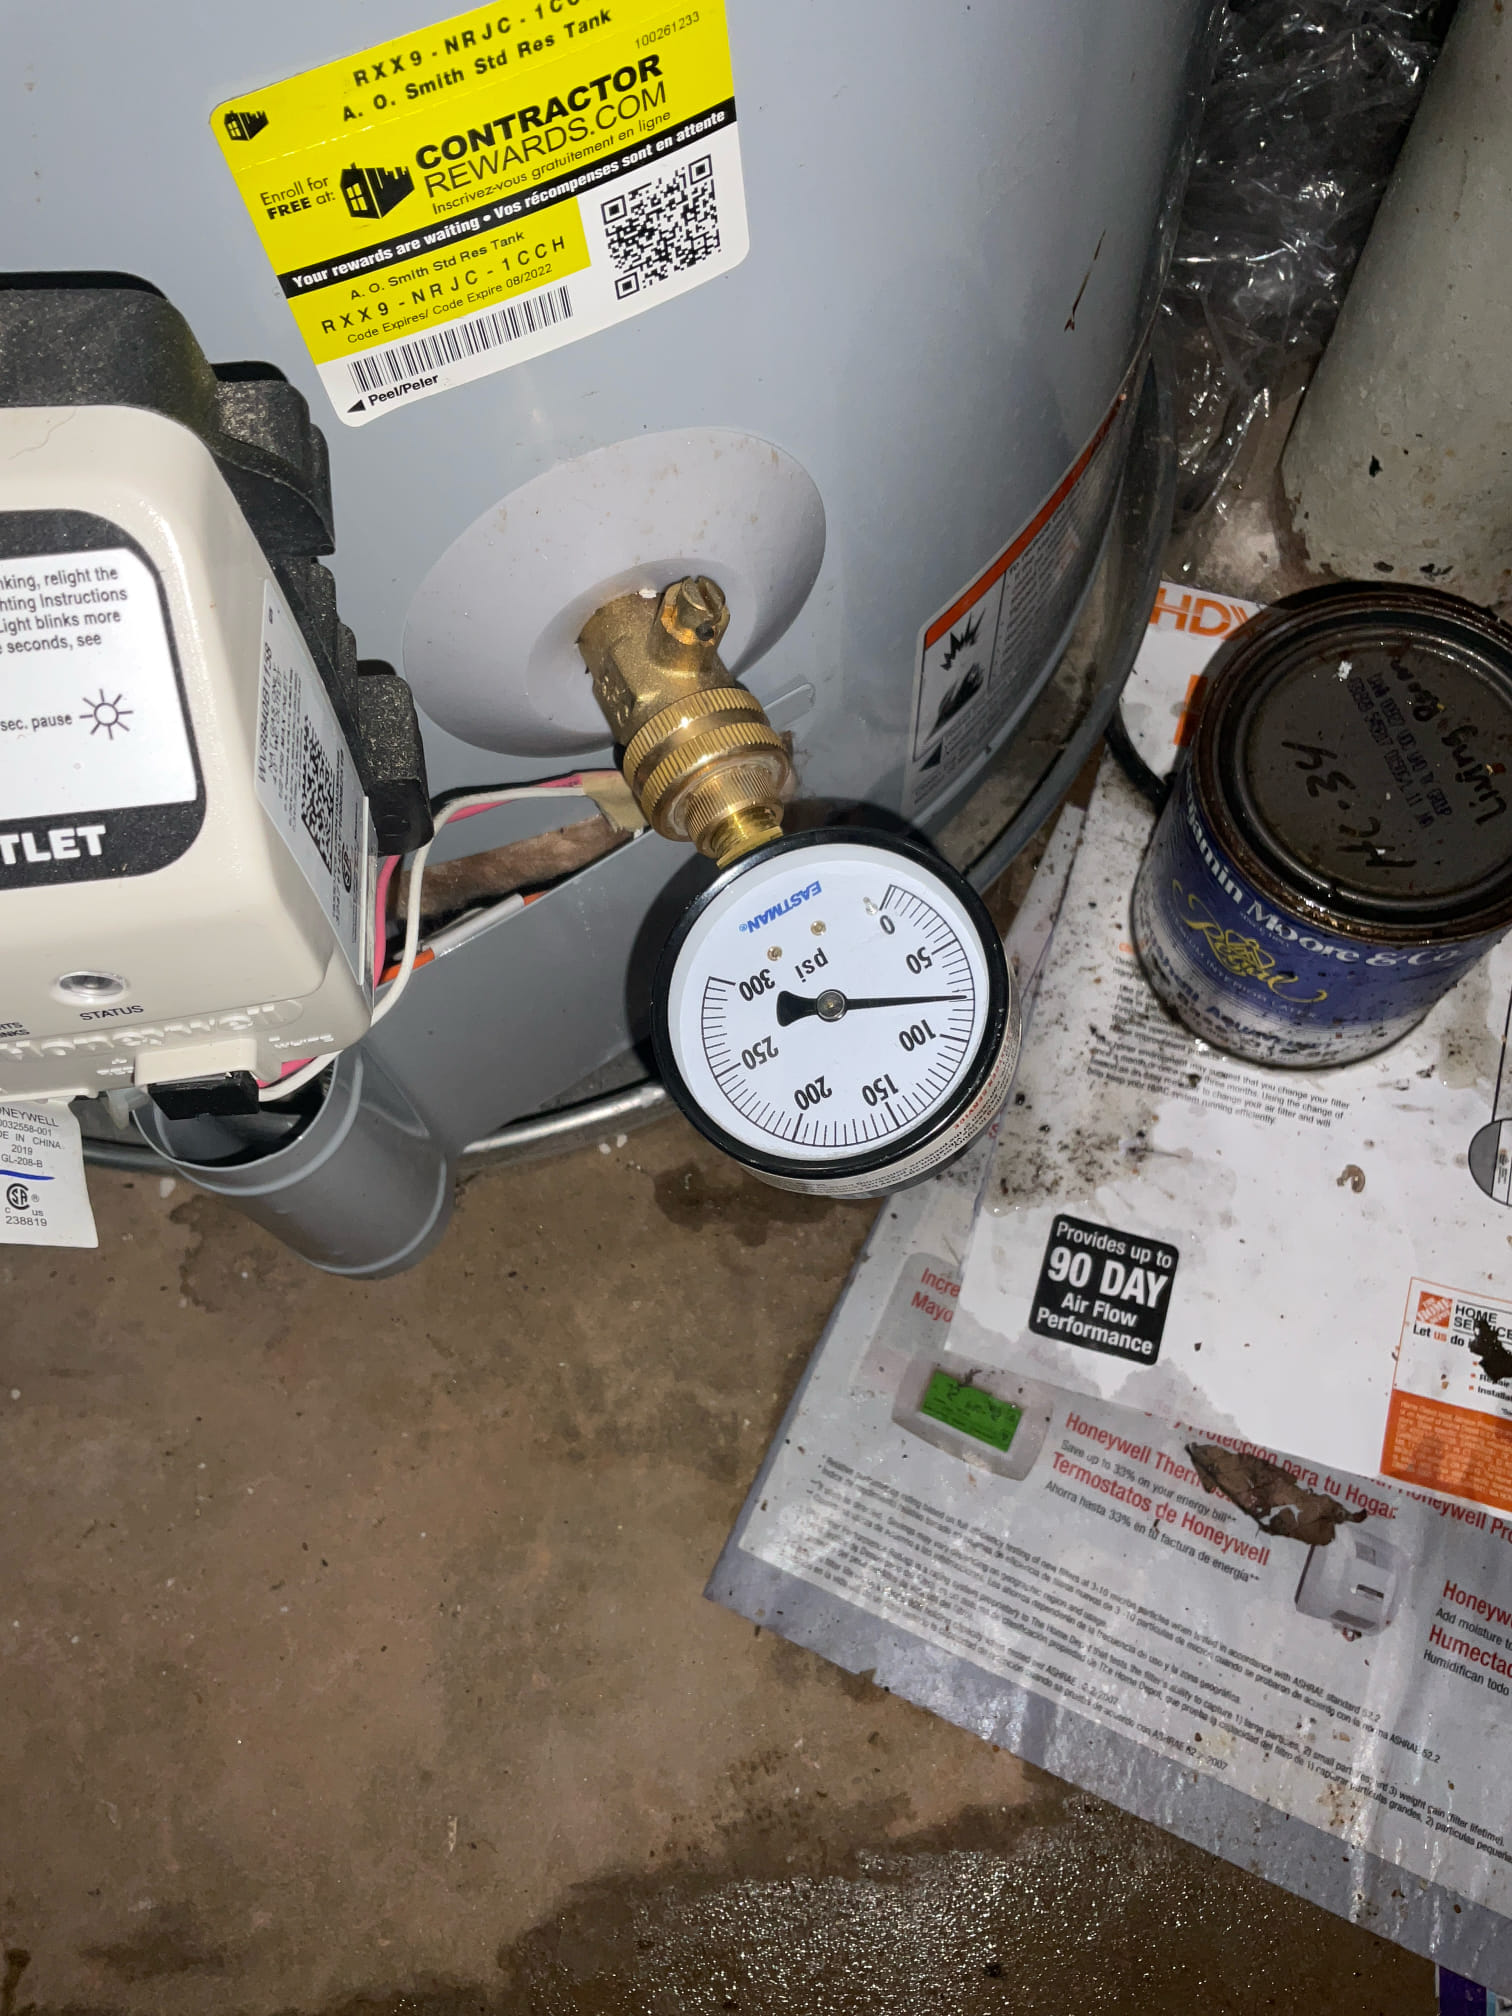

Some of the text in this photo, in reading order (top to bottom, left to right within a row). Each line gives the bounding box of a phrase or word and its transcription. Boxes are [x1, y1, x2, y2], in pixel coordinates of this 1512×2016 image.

[636, 11, 700, 48] 100261233
[338, 10, 611, 124] A. O. Smith Std Res Tank
[416, 54, 663, 170] CONTRACTOR
[424, 81, 666, 198] REWARDS.COM
[432, 112, 670, 215] Inscrivez-vous gratuitement en ligne
[260, 176, 329, 206] Enroll for
[266, 190, 336, 220] FREE at:
[292, 111, 725, 288] Your rewards are waiting Vos récompenses sont en attente
[347, 232, 524, 303] A. O. Smith Std Res Tank
[347, 263, 552, 343] Code Expires/ Code Expire 08/2022
[368, 375, 438, 406] Peel/Peler
[44, 568, 92, 588] relight
[94, 566, 118, 580] the
[40, 588, 128, 609] Instructions
[35, 612, 80, 630] blinks
[84, 610, 121, 625] more
[8, 634, 74, 654] seconds,
[77, 634, 102, 647] see
[32, 714, 72, 732] pause
[1441, 721, 1509, 826] Living
[879, 915, 896, 936] 0
[1246, 900, 1361, 963] Moore
[795, 948, 829, 983] psi
[906, 946, 932, 974] 50
[738, 968, 776, 1002] 300
[79, 1004, 144, 1022] STATUS
[740, 1036, 779, 1070] 250
[898, 1020, 937, 1052] 100
[794, 1076, 832, 1110] 200
[861, 1074, 900, 1106] 150
[1276, 1084, 1309, 1101] change
[1309, 1093, 1328, 1106] your
[1329, 1097, 1350, 1110] filter
[1276, 1105, 1297, 1119] filter
[1297, 1112, 1314, 1123] and
[1315, 1116, 1332, 1128] will
[1286, 1097, 1344, 1120] the change of
[11, 1144, 33, 1156] 2019
[16, 1134, 24, 1142] IN
[1, 1154, 43, 1168] GL-208-B
[6, 1216, 47, 1226] 238819
[1056, 1221, 1172, 1268] Provides up to
[921, 1266, 960, 1298] Incre
[1048, 1247, 1168, 1308] 90 DAY
[912, 1291, 954, 1322] Mayo
[1061, 1292, 1137, 1326] Air Flow
[1455, 1304, 1498, 1324] HOME
[1036, 1307, 1153, 1355] Performance
[1412, 1324, 1464, 1347] Let us do
[1066, 1412, 1152, 1464] Honeywell
[1061, 1440, 1084, 1458] Save
[1086, 1455, 1100, 1465] up
[1102, 1458, 1111, 1470] to
[1114, 1464, 1135, 1482] 33%
[1138, 1477, 1150, 1488] on
[1152, 1484, 1175, 1498] your
[1176, 1494, 1210, 1516] energy
[1053, 1452, 1270, 1566] Termostatos de Honeywell
[1321, 1474, 1343, 1496] tu
[1341, 1483, 1401, 1525] Hogar.
[1045, 1480, 1078, 1503] Ahorra
[1079, 1496, 1106, 1516] hasta
[1108, 1509, 1131, 1527] 33%
[1134, 1522, 1146, 1534] en
[1160, 1533, 1196, 1557] factura
[1198, 1552, 1210, 1564] de
[1442, 1580, 1512, 1628] Honeyw
[1436, 1608, 1456, 1624] Add
[1458, 1618, 1502, 1646] moisture
[1424, 1648, 1510, 1696] Humidifican todo
[1420, 1748, 1441, 1764] 52.2
[1311, 1750, 1428, 1811] small weight
